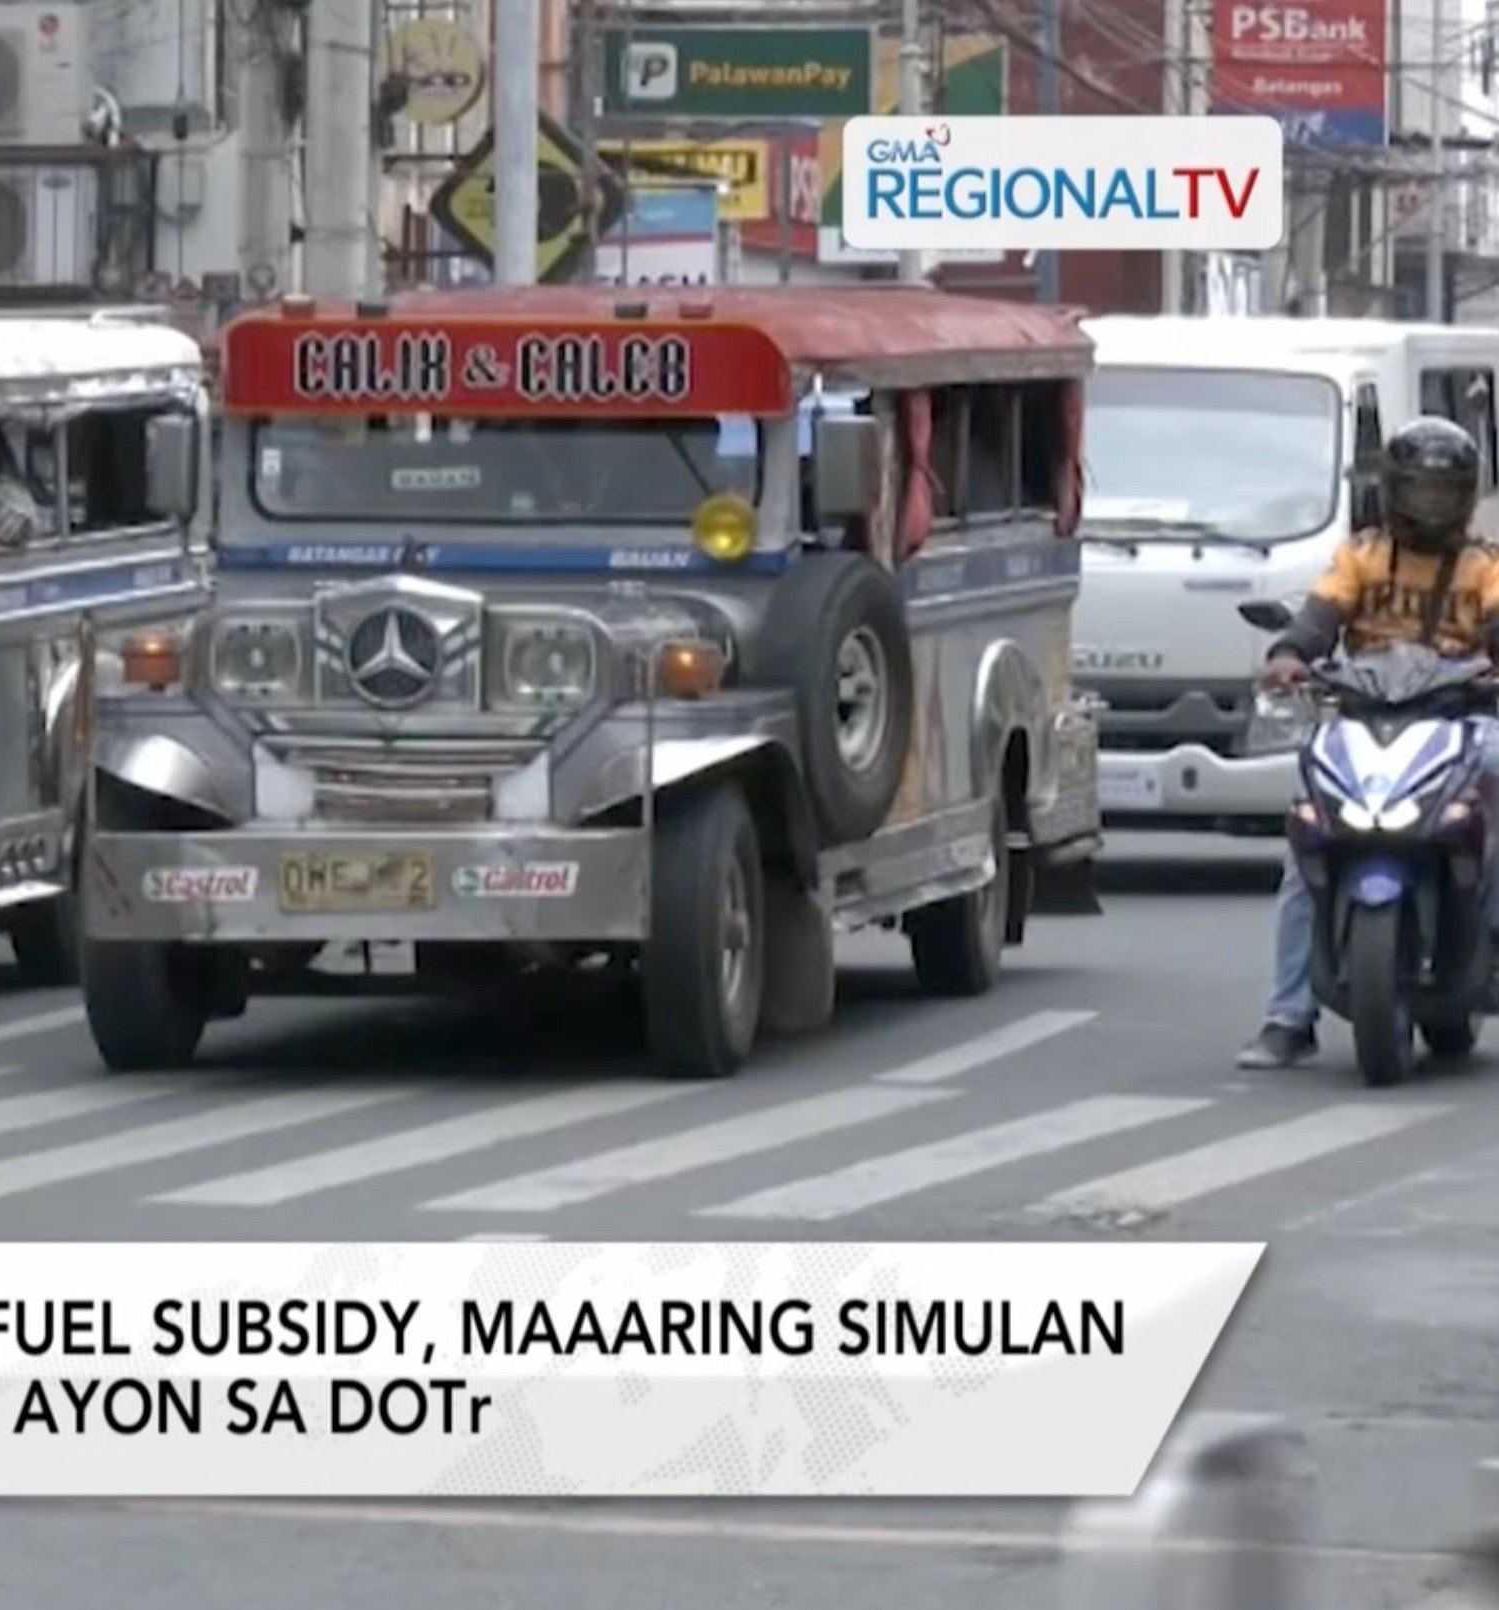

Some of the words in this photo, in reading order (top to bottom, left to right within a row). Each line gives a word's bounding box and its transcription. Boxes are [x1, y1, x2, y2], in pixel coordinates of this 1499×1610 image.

[1232, 7, 1367, 41] PSBank
[688, 60, 851, 89] PalawanPay
[1253, 77, 1344, 98] Batangas
[462, 345, 509, 387] &
